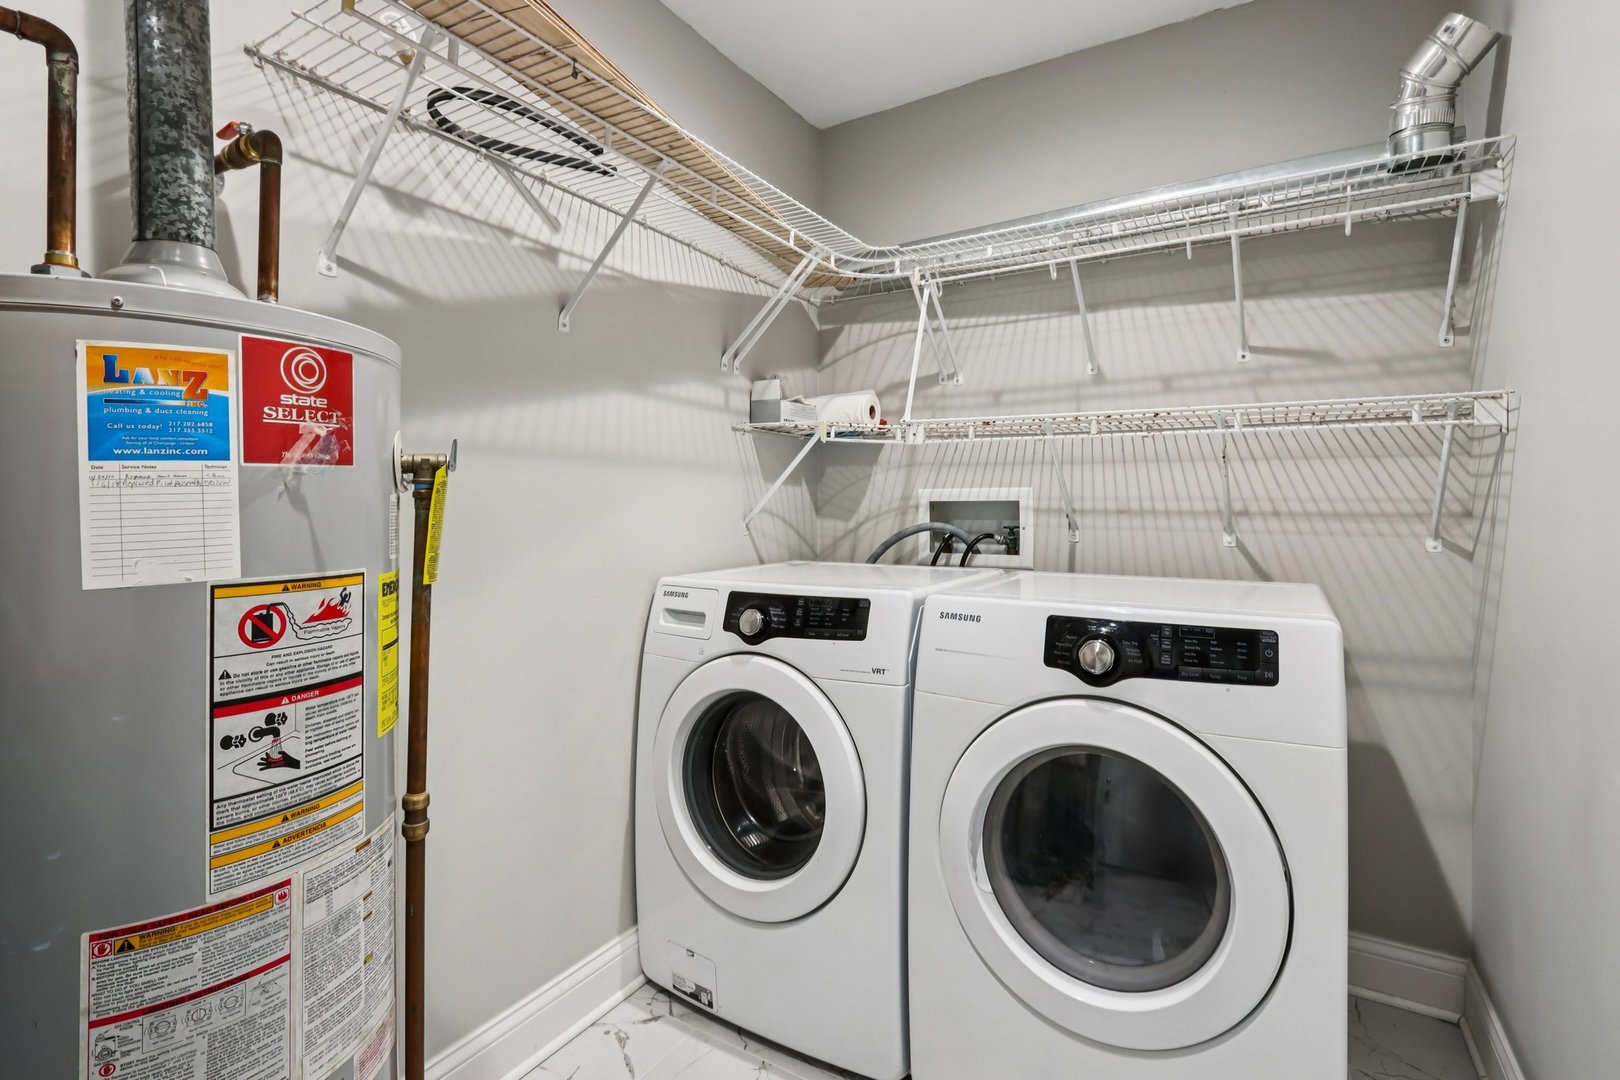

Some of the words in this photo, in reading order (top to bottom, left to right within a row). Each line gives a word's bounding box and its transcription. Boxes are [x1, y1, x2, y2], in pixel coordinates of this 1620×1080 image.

[103, 354, 208, 400] LANZ
[280, 394, 327, 408] state
[176, 408, 208, 416] cleaning
[263, 406, 340, 423] SELECT
[113, 447, 208, 455] www.lanzinc.com
[291, 582, 322, 590] WARNING
[663, 590, 689, 599] SAMSUNG
[940, 611, 982, 623] SAMSUNG
[292, 690, 320, 701] DANGER
[290, 803, 320, 818] WARNING
[282, 822, 326, 844] ADVERTENCIA
